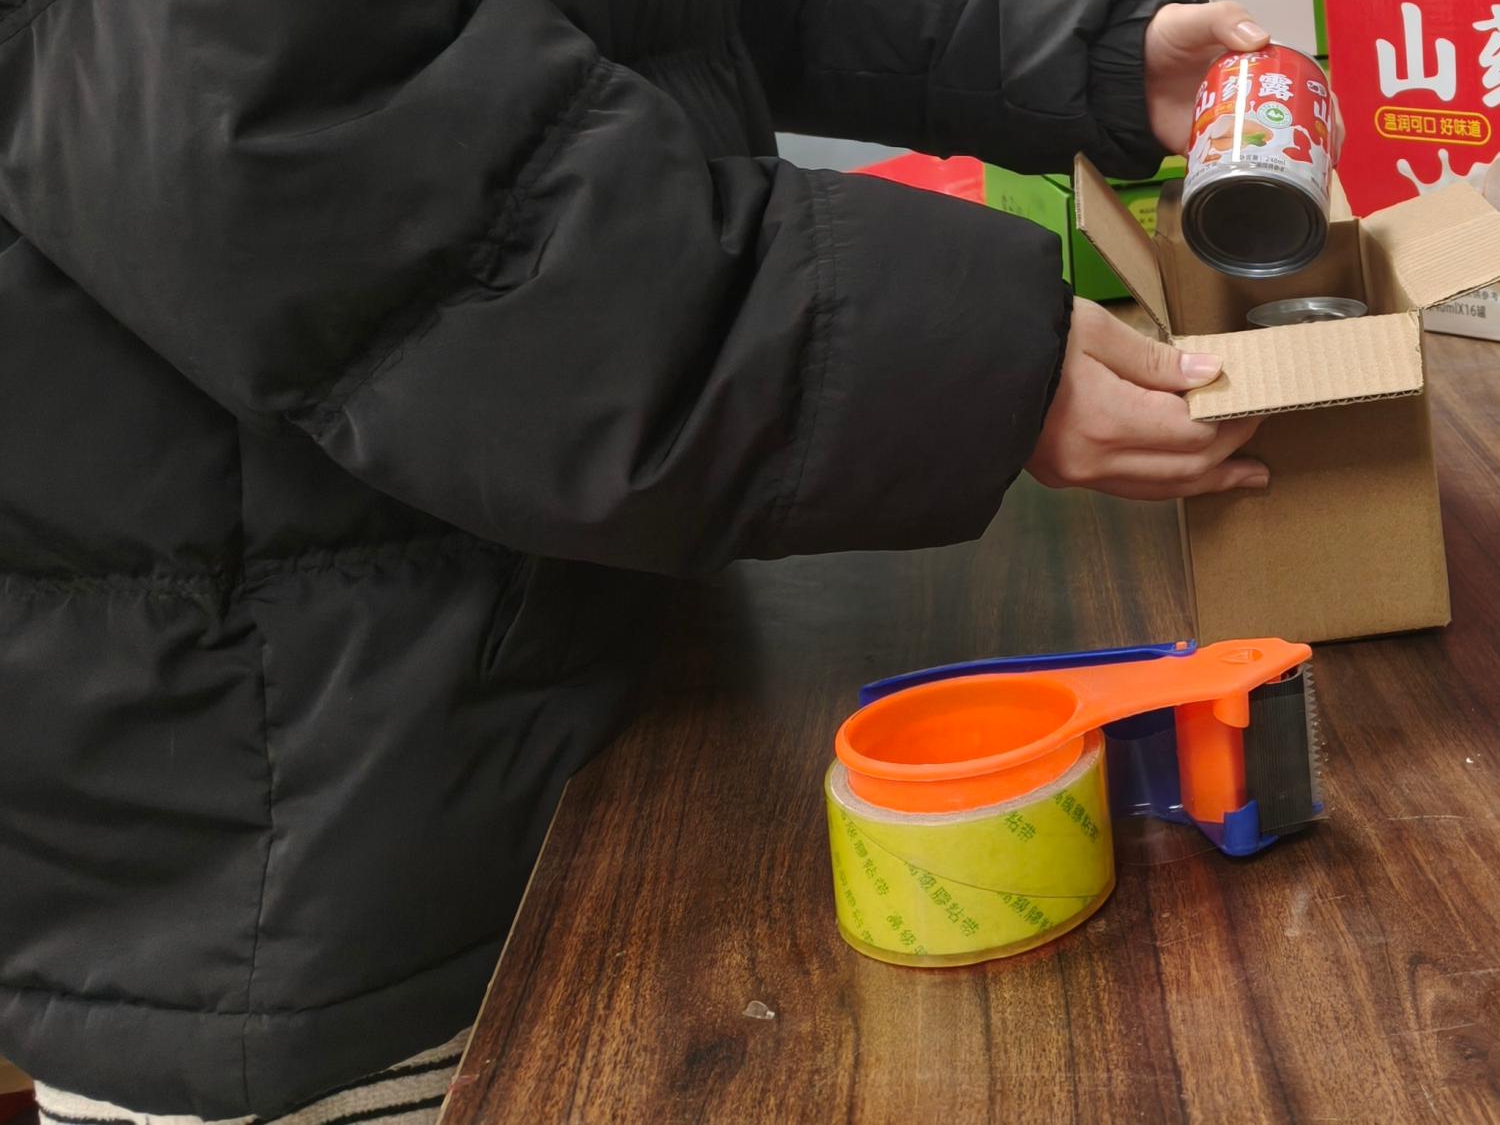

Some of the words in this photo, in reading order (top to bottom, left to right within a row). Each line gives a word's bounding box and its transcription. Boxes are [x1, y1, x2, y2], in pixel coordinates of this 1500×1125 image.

[1384, 113, 1436, 133] 温润可口
[1440, 118, 1481, 137] 好味道
[1470, 290, 1499, 301] 供参考
